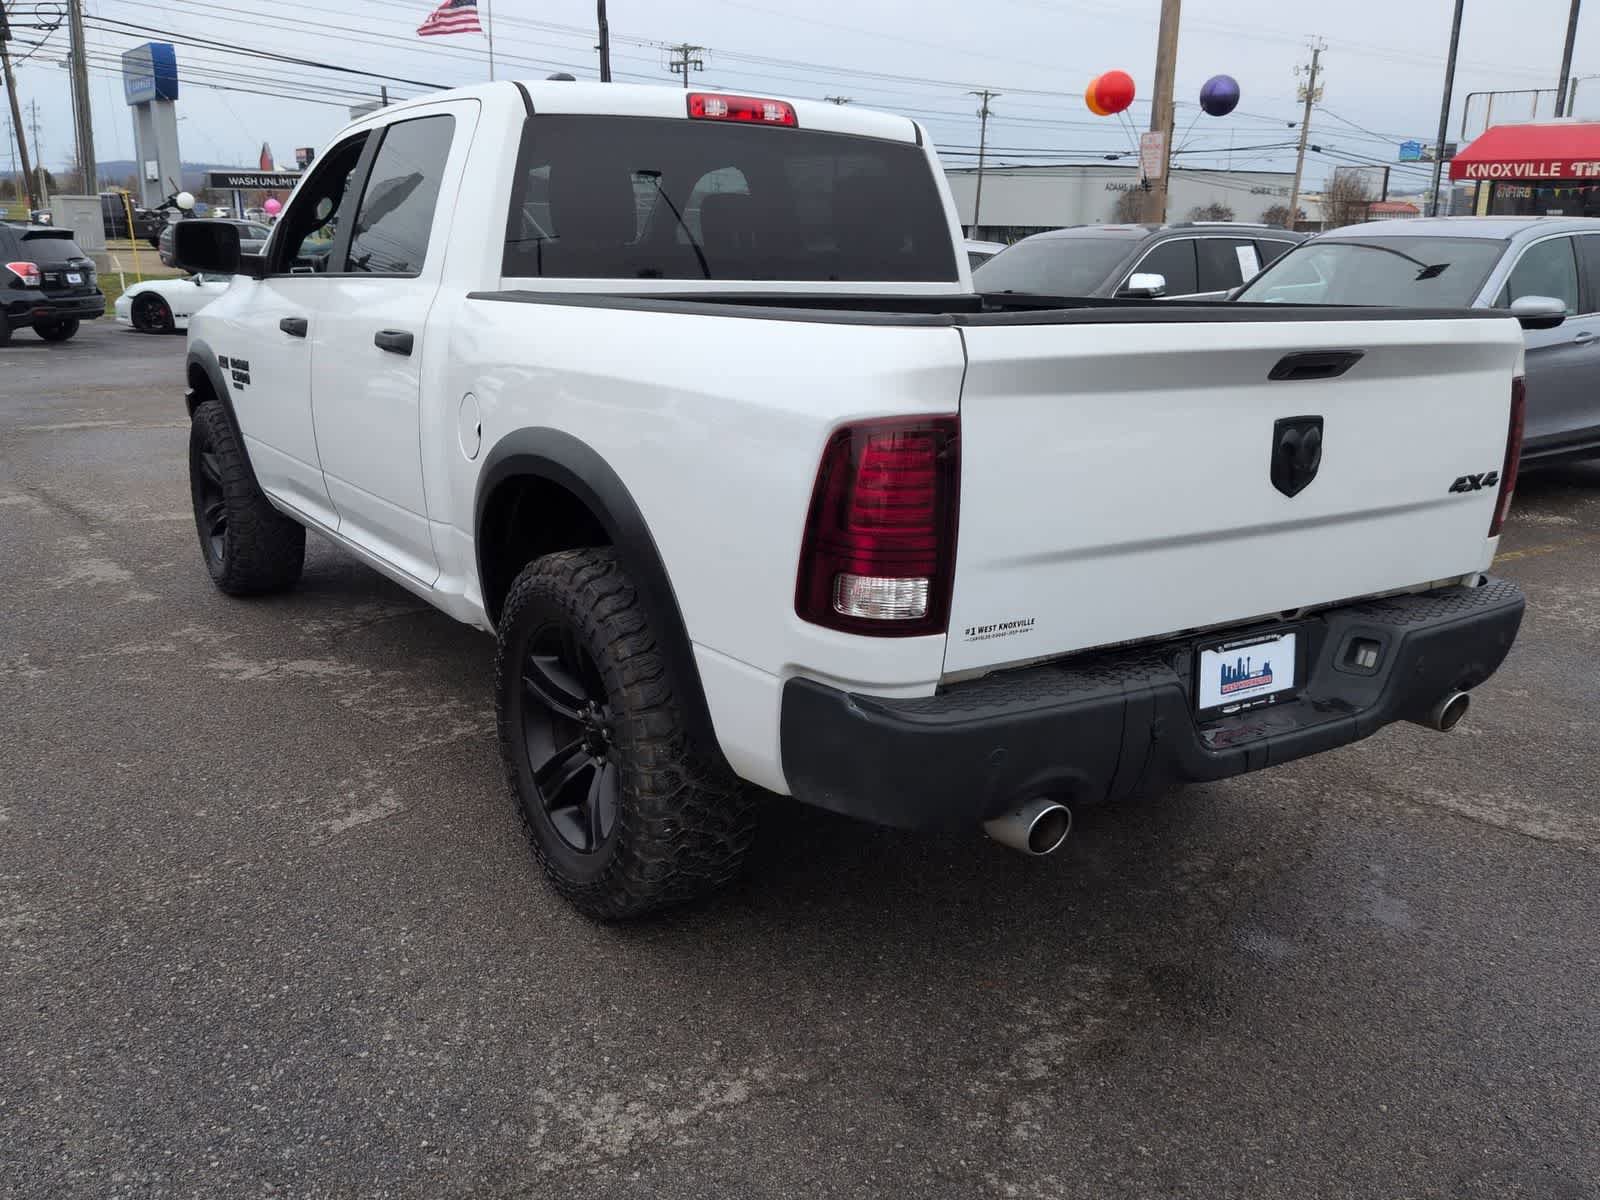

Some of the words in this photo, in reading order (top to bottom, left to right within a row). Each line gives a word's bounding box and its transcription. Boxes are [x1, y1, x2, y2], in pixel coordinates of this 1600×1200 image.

[1465, 162, 1562, 177] KNOXVILLE
[228, 176, 258, 186] WASH
[260, 177, 299, 186] UNLIMIT
[964, 627, 976, 636] #1
[977, 624, 998, 634] WEST
[998, 618, 1036, 631] KNOXVILLE
